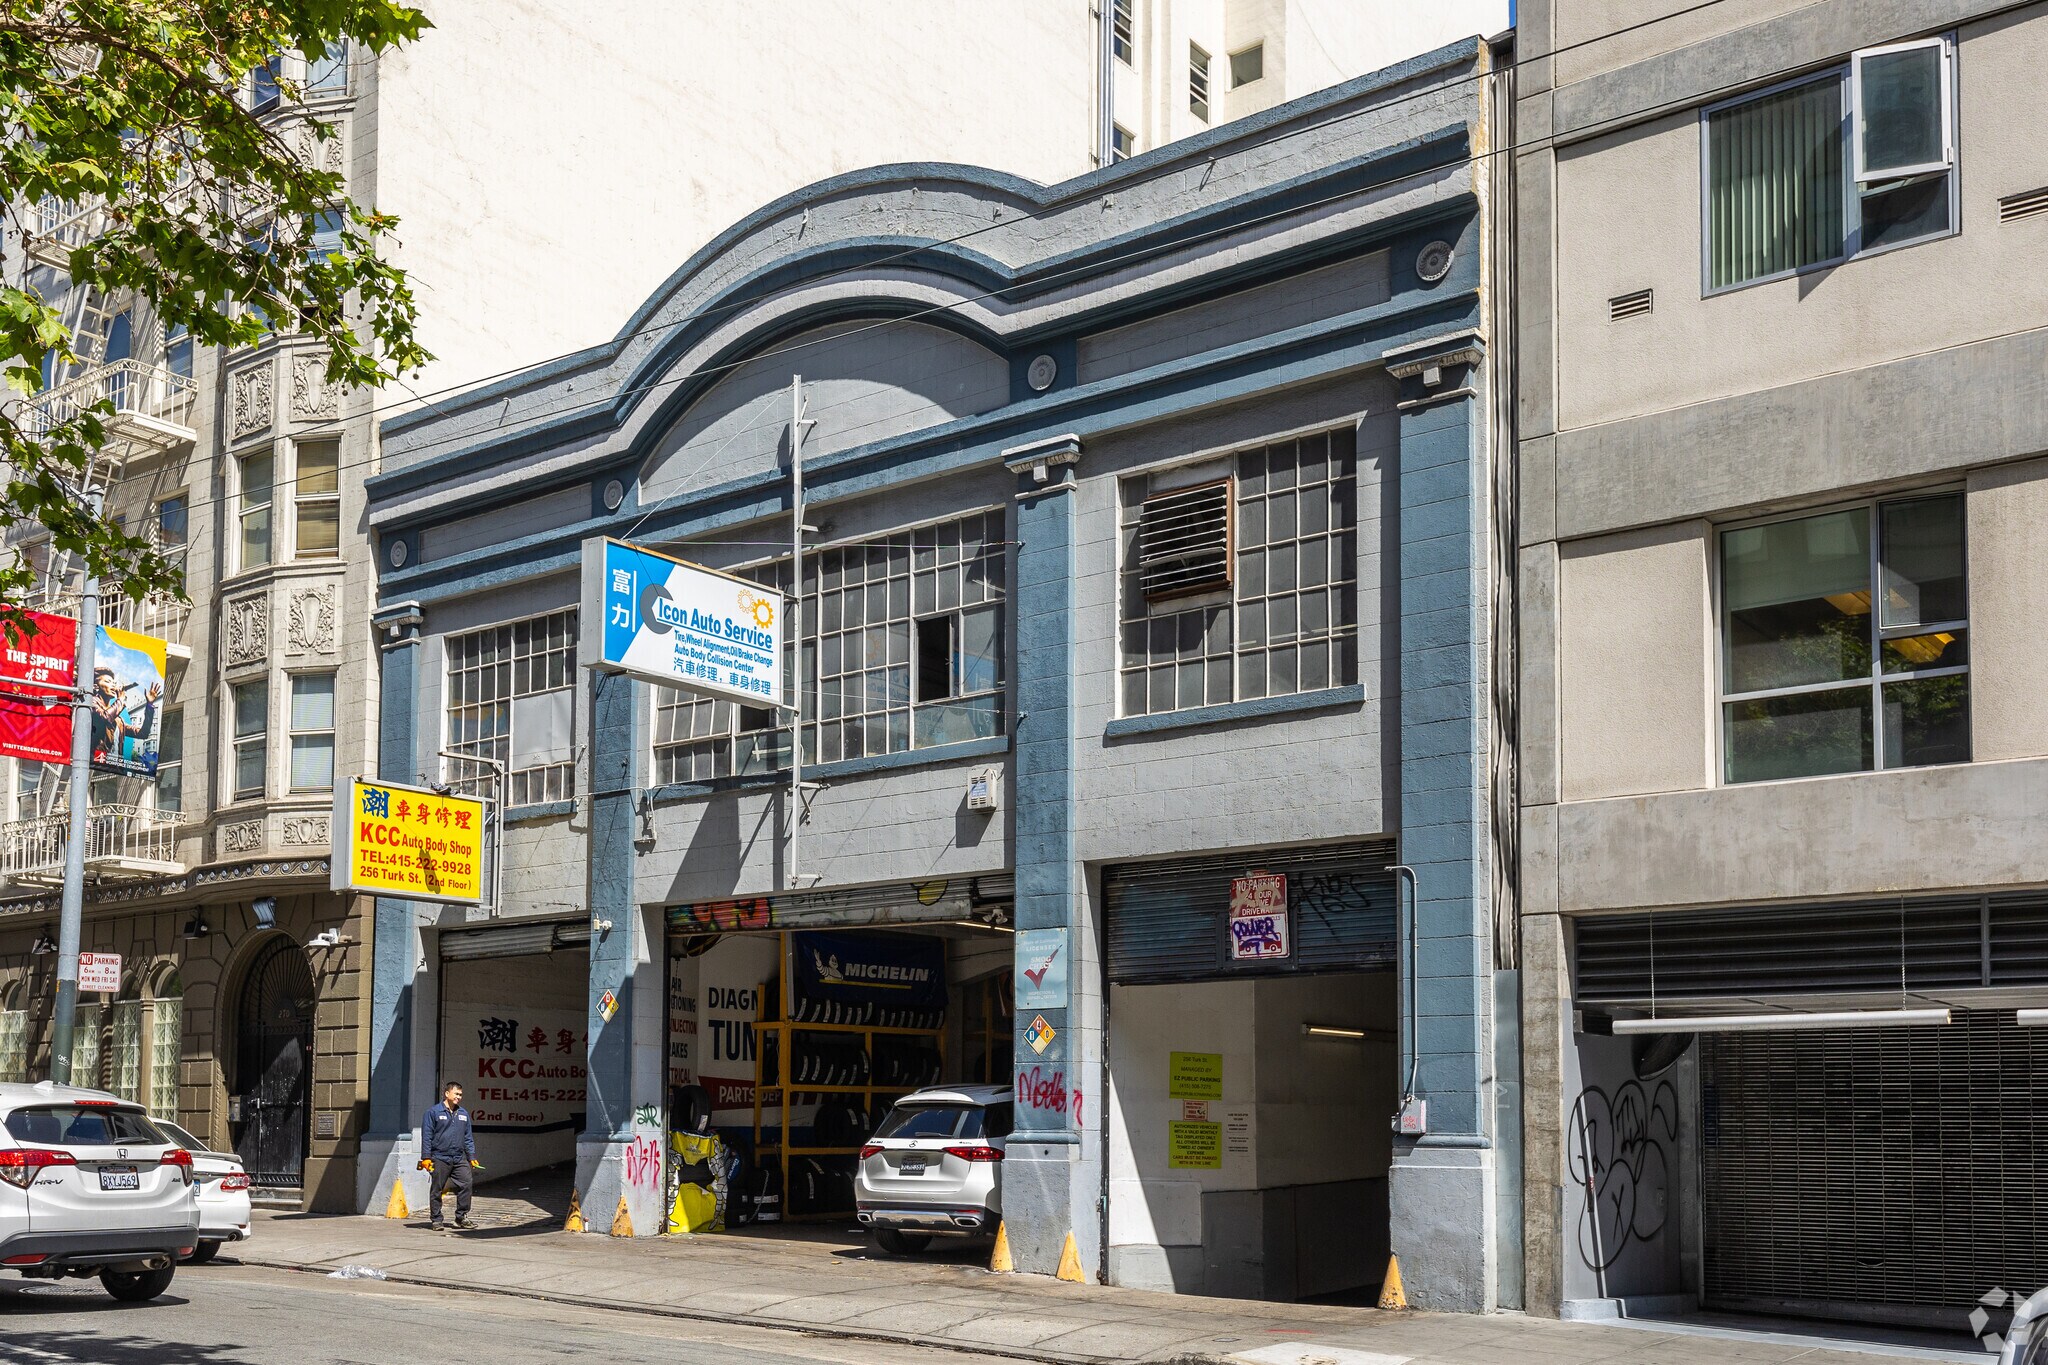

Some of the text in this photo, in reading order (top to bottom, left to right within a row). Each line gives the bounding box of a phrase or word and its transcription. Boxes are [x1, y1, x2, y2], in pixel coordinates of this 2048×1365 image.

[611, 568, 631, 629] 富力
[659, 597, 773, 649] Icon Auto Service
[6, 649, 70, 671] THE SPIRIT
[674, 643, 754, 673] Auto Body Collision Center
[753, 653, 773, 668] Change
[35, 668, 49, 681] SF
[362, 788, 472, 830] 潮 車身修理
[361, 822, 472, 859] KCC Auto Body Shop
[361, 849, 471, 875] TEL:415-222-9928
[360, 866, 379, 879] 256
[381, 869, 405, 882] Turk
[408, 872, 422, 884] St.
[1237, 876, 1280, 892] NO PARKING
[81, 955, 119, 965] NO PARKING
[845, 963, 929, 981] MICHELIN
[671, 976, 682, 992] AIR
[526, 1026, 588, 1055] 車身
[478, 1058, 535, 1079] KCC
[536, 1065, 568, 1079] Auto
[719, 1085, 756, 1103] PARTS
[471, 1110, 503, 1121] (2nd
[508, 1112, 544, 1122] Floor)
[103, 1175, 136, 1187] 8XYJ569
